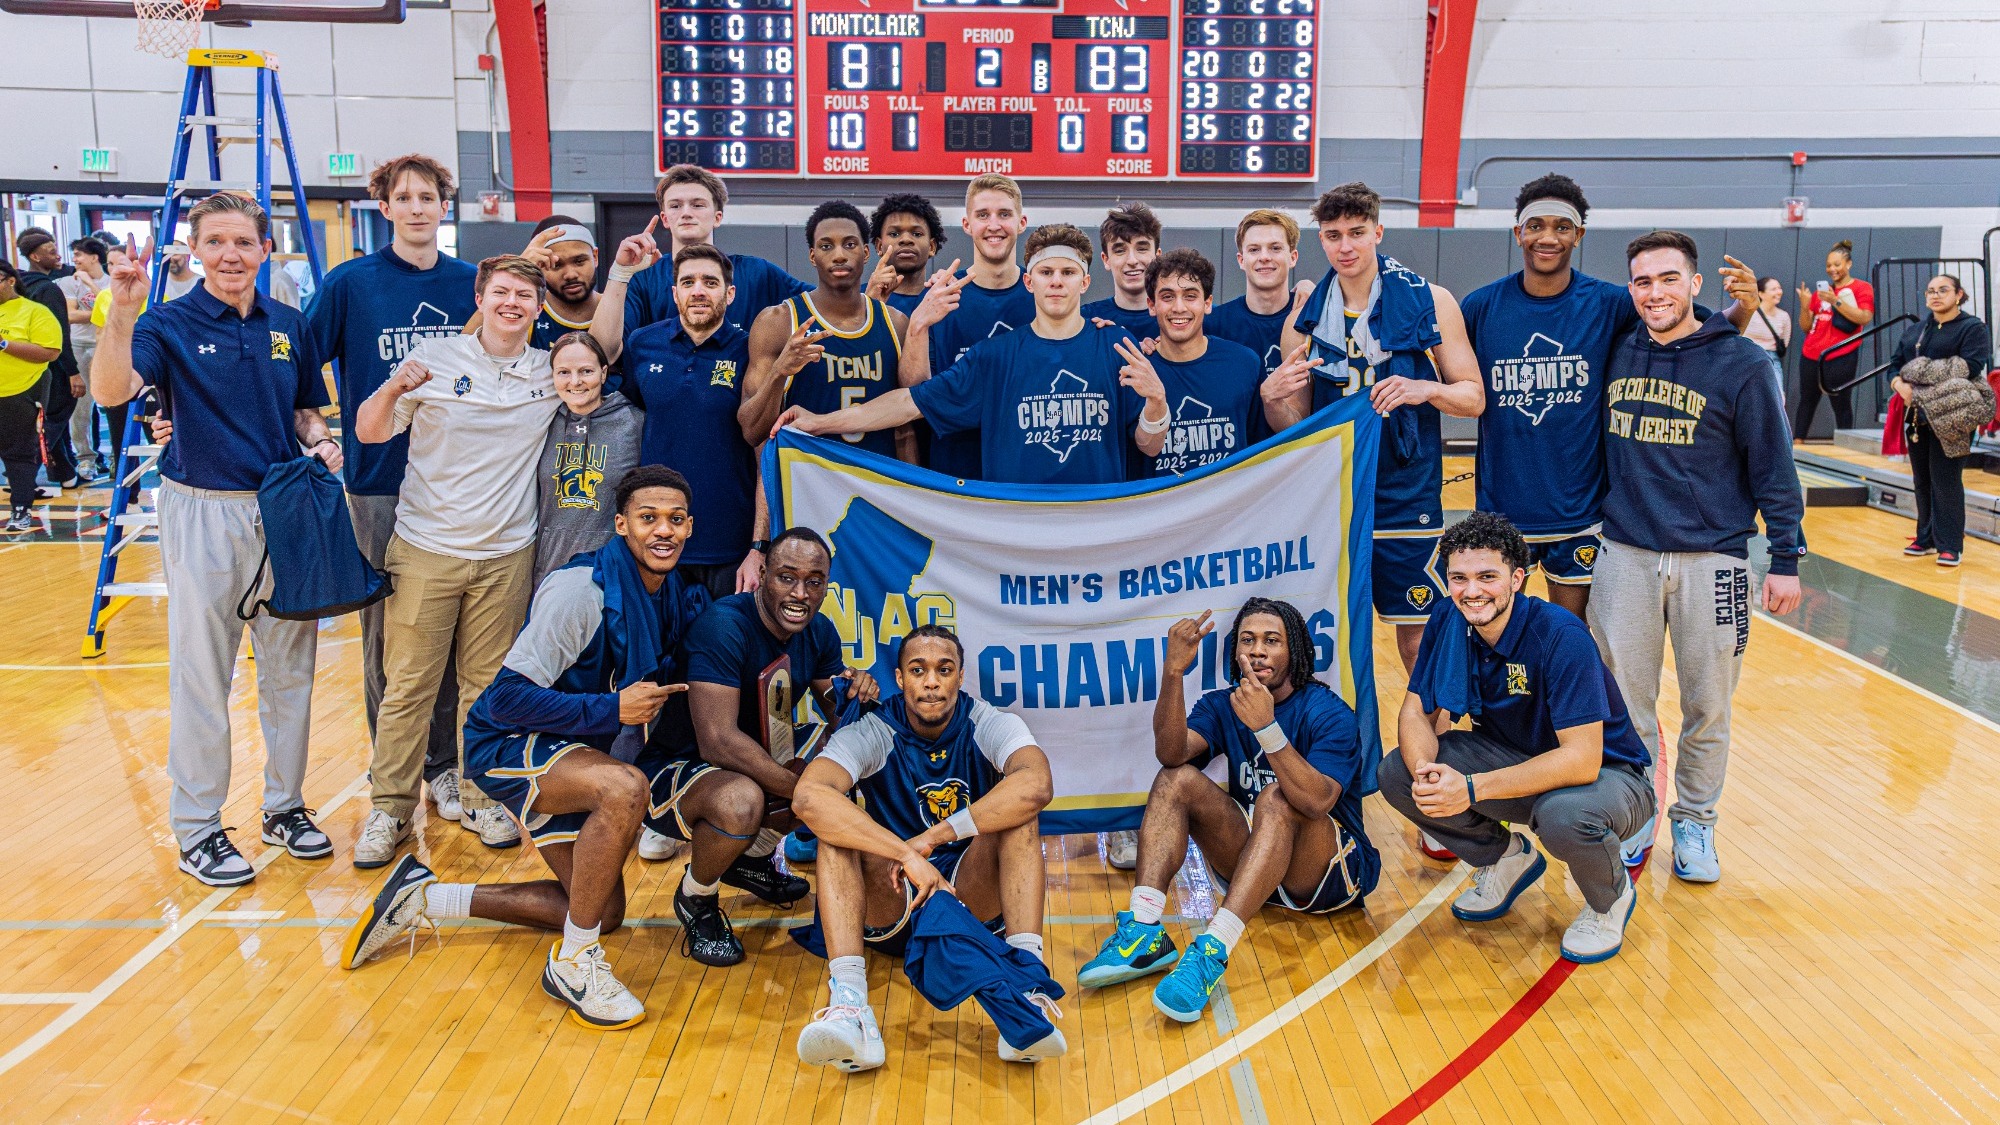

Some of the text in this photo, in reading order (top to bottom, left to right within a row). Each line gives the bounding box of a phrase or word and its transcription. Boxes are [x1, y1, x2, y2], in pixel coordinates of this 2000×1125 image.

[681, 15, 791, 40] 4 0 11
[811, 13, 919, 36] MONTCLAIR
[963, 28, 1014, 44] PERIOD
[1086, 17, 1135, 38] TCNJ
[1203, 19, 1312, 46] 5 1 8
[683, 46, 791, 73] 7 4 18
[842, 42, 899, 89] 81
[978, 49, 999, 86] 2
[1089, 45, 1147, 91] 83
[1184, 51, 1312, 78] 20 0 2
[673, 78, 791, 104] 11 3 11
[824, 95, 869, 110] FOULS
[888, 96, 924, 111] T.O.L.
[943, 96, 1037, 112] PLAYER FOUL
[1186, 82, 1311, 109] 33 2 22
[1054, 98, 1091, 112] T.O.L.
[1107, 98, 1152, 112] FOULS
[664, 109, 792, 136] 25 2 12
[829, 113, 862, 149] 10
[905, 115, 916, 147] 1
[1059, 115, 1082, 151] 0
[1123, 115, 1146, 151] 6
[1186, 113, 1310, 141] 35 0 2
[83, 149, 109, 171] EXIT
[329, 154, 354, 175] EXIT
[721, 141, 746, 168] 10
[823, 157, 869, 172] SCORE
[964, 158, 1012, 173] MATCH
[1107, 158, 1152, 173] SCORE
[1246, 145, 1262, 171] 6
[715, 360, 737, 371] TCNJ
[821, 350, 882, 383] TCNJ
[1608, 377, 1627, 407] THE
[1686, 390, 1707, 419] OF
[1635, 416, 1697, 444] JERSEY
[555, 443, 607, 471] TCNJ
[1000, 534, 1315, 605] MEN'S BASKETBALL
[1715, 569, 1733, 626] & FITCH
[978, 608, 1335, 709] CHAMIS
[1505, 662, 1527, 678] TCNJ
